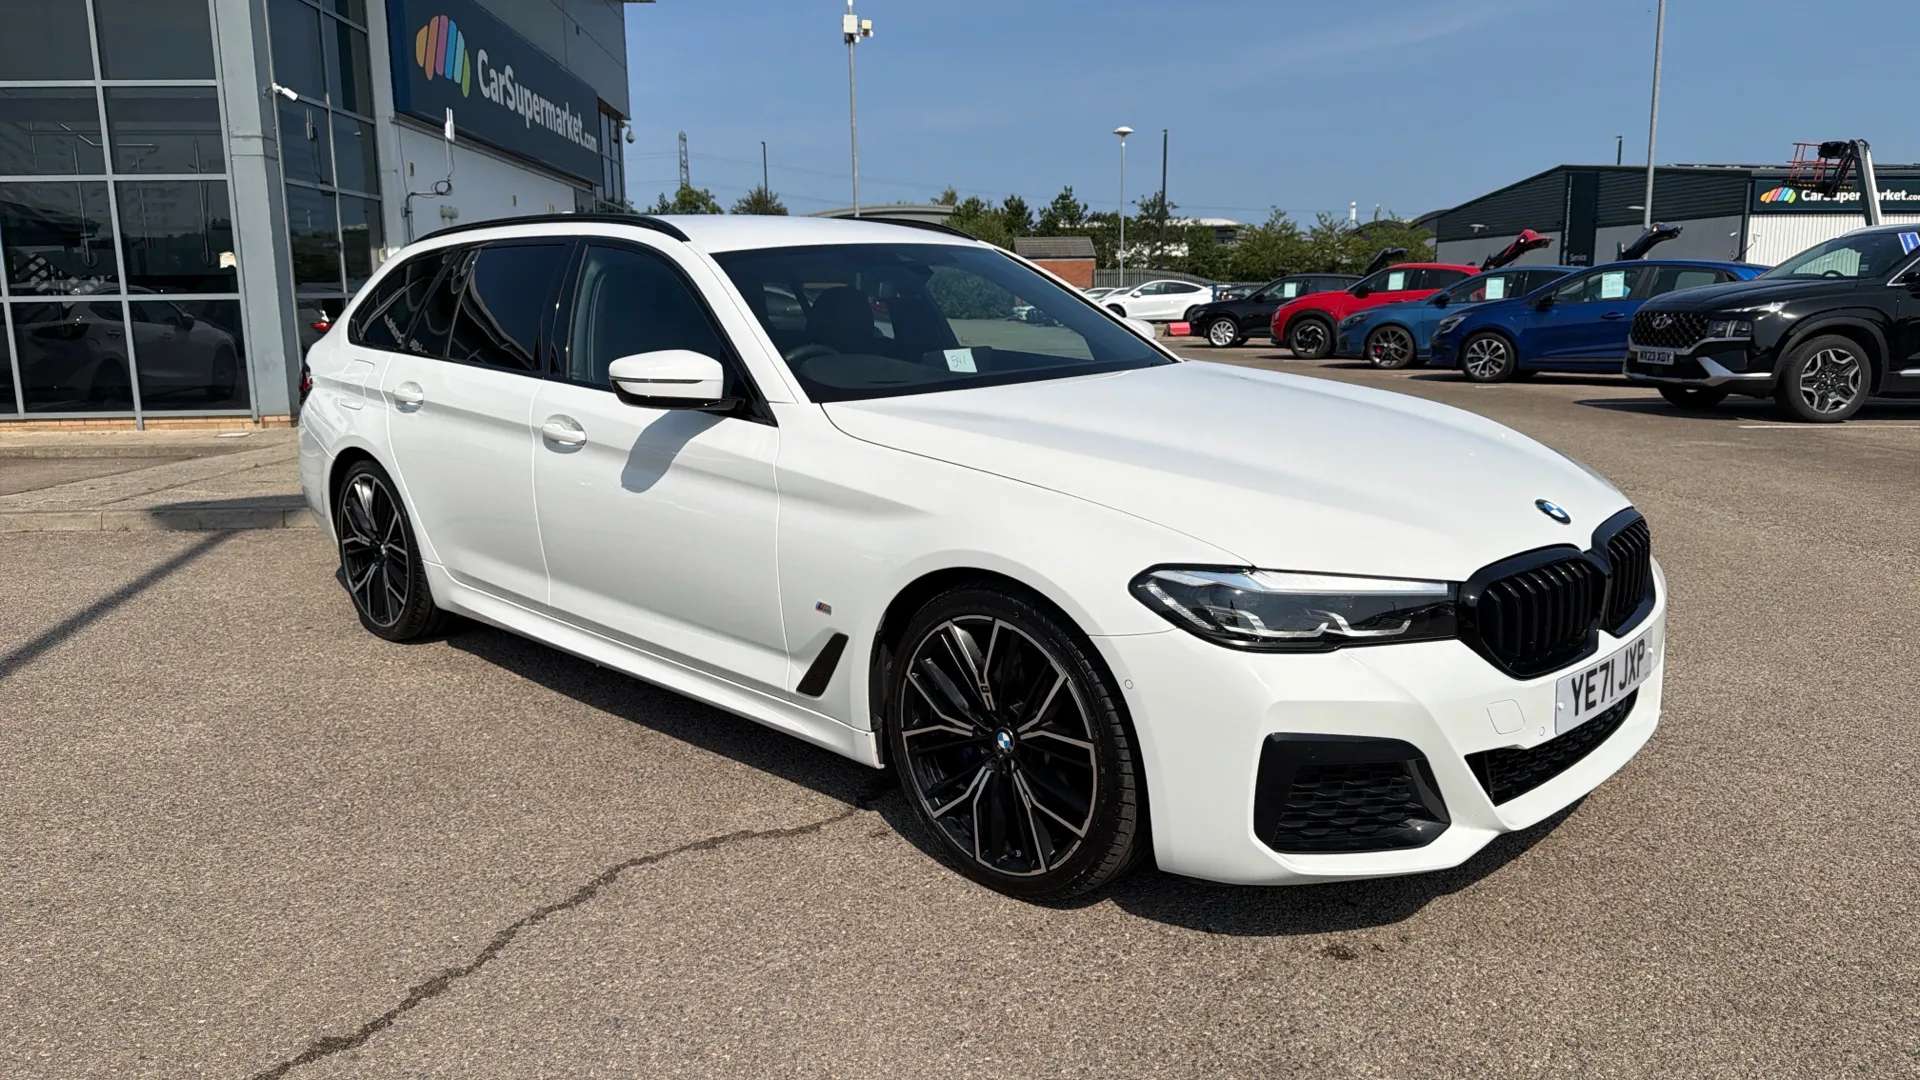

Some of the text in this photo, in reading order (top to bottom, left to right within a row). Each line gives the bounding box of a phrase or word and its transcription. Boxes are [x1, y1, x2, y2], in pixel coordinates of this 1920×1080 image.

[477, 48, 598, 153] CarSupermarket.com
[1571, 638, 1646, 717] YE71 JXP
